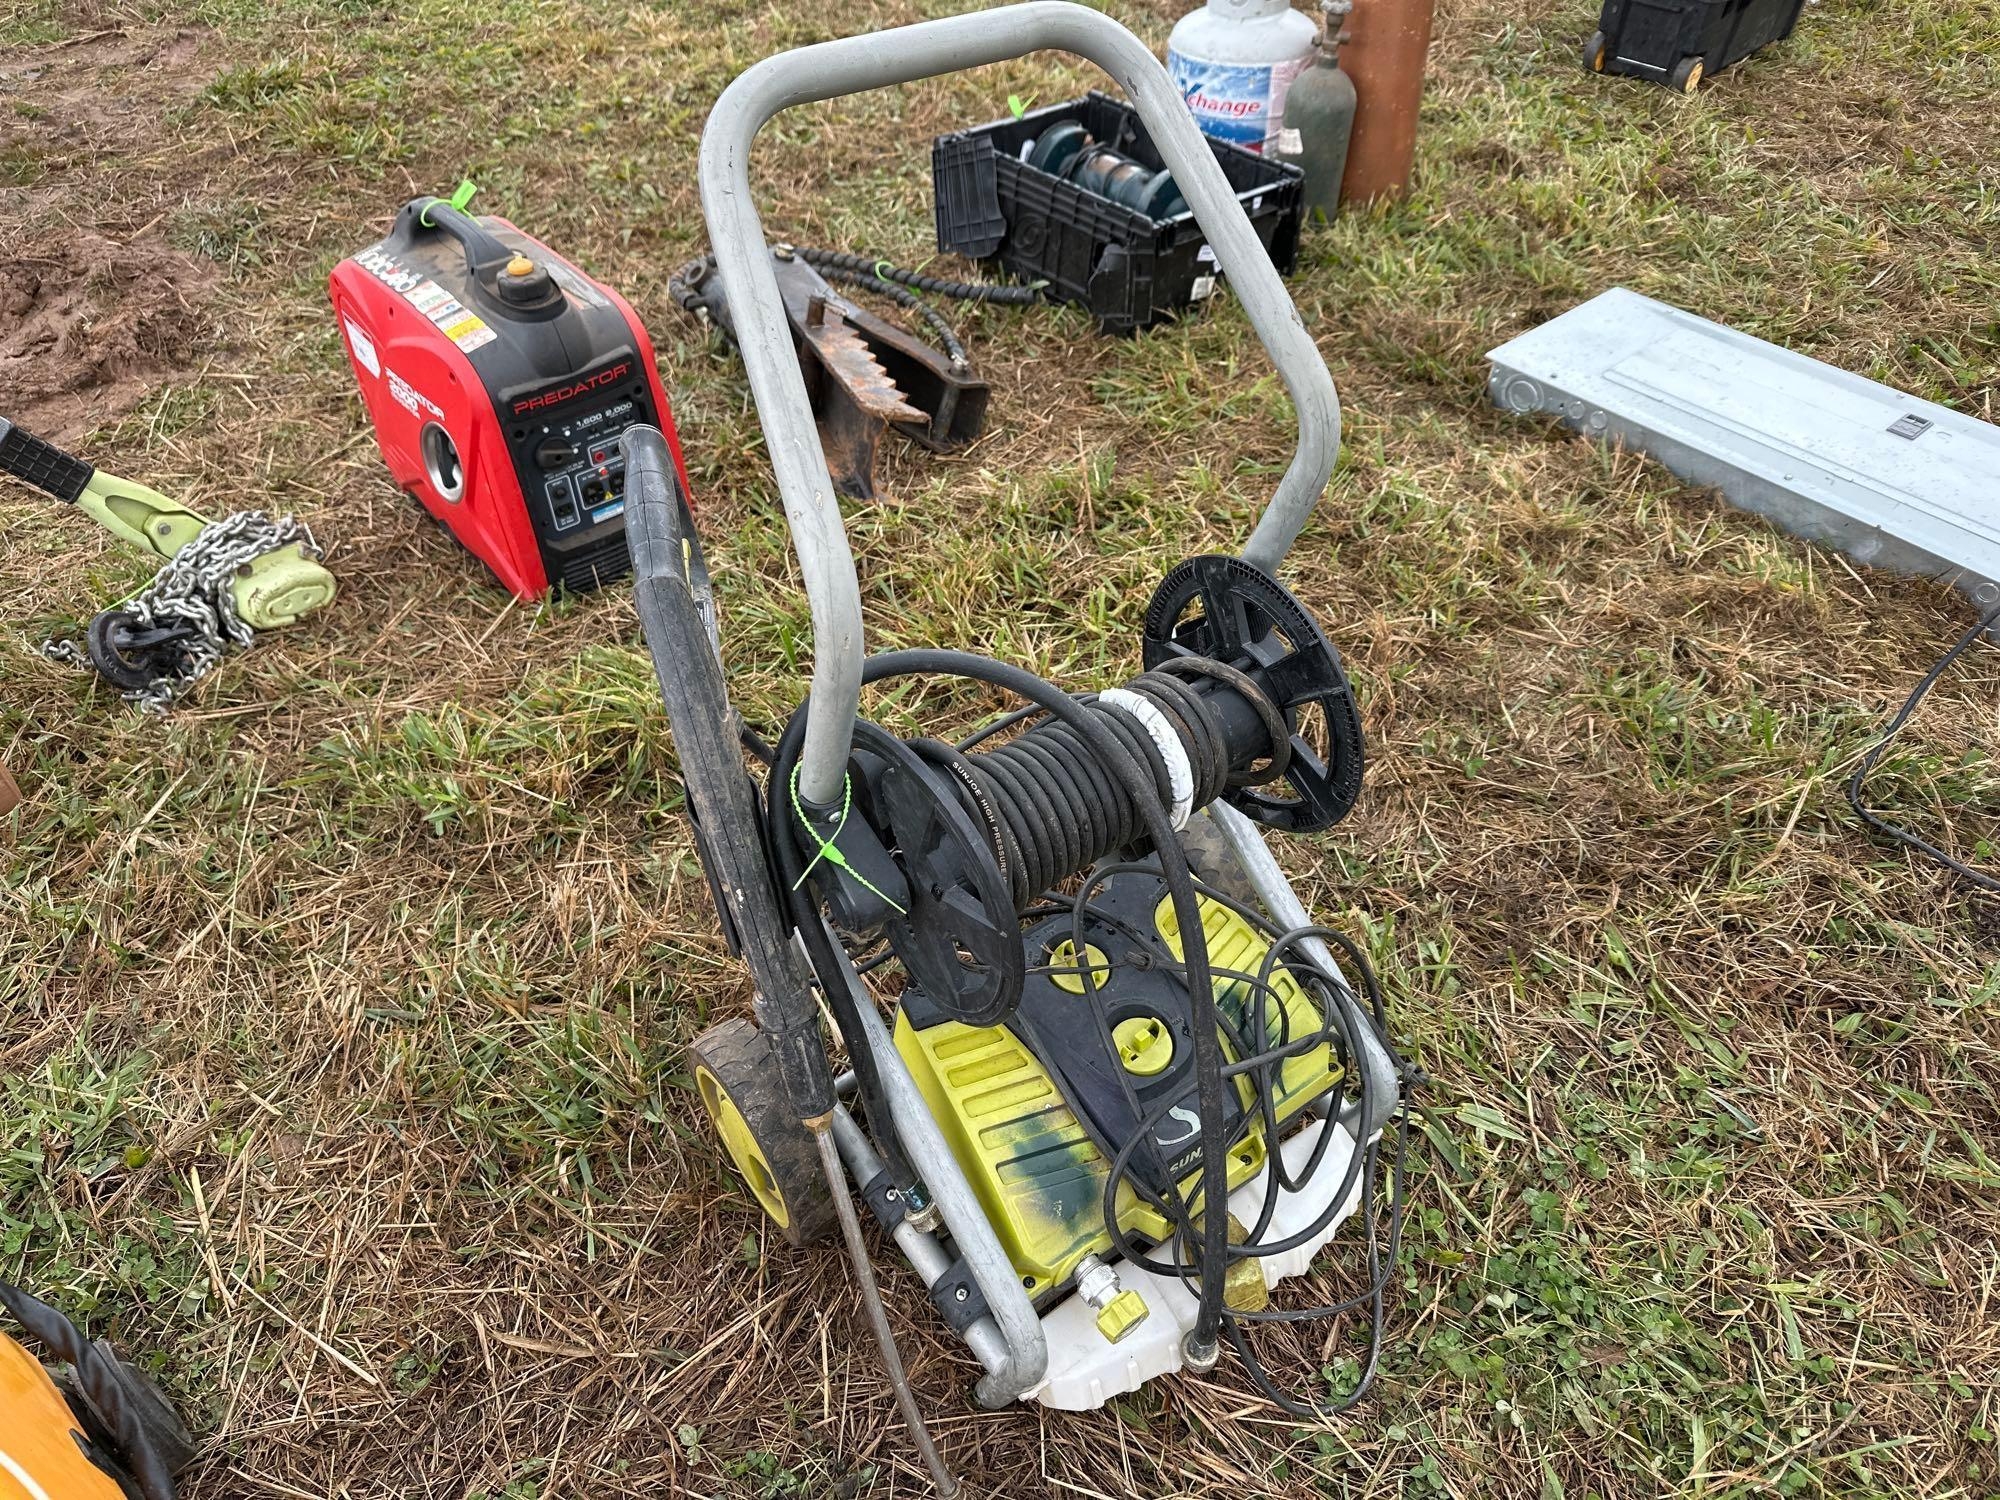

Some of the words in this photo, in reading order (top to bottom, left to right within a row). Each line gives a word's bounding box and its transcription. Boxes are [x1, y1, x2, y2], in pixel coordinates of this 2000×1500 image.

[513, 363, 630, 416] PREDATOR
[952, 761, 983, 797] SUNJOE
[980, 798, 995, 823] HIGH
[992, 826, 1008, 874] PRESSURE
[1169, 1146, 1204, 1175] SUN
